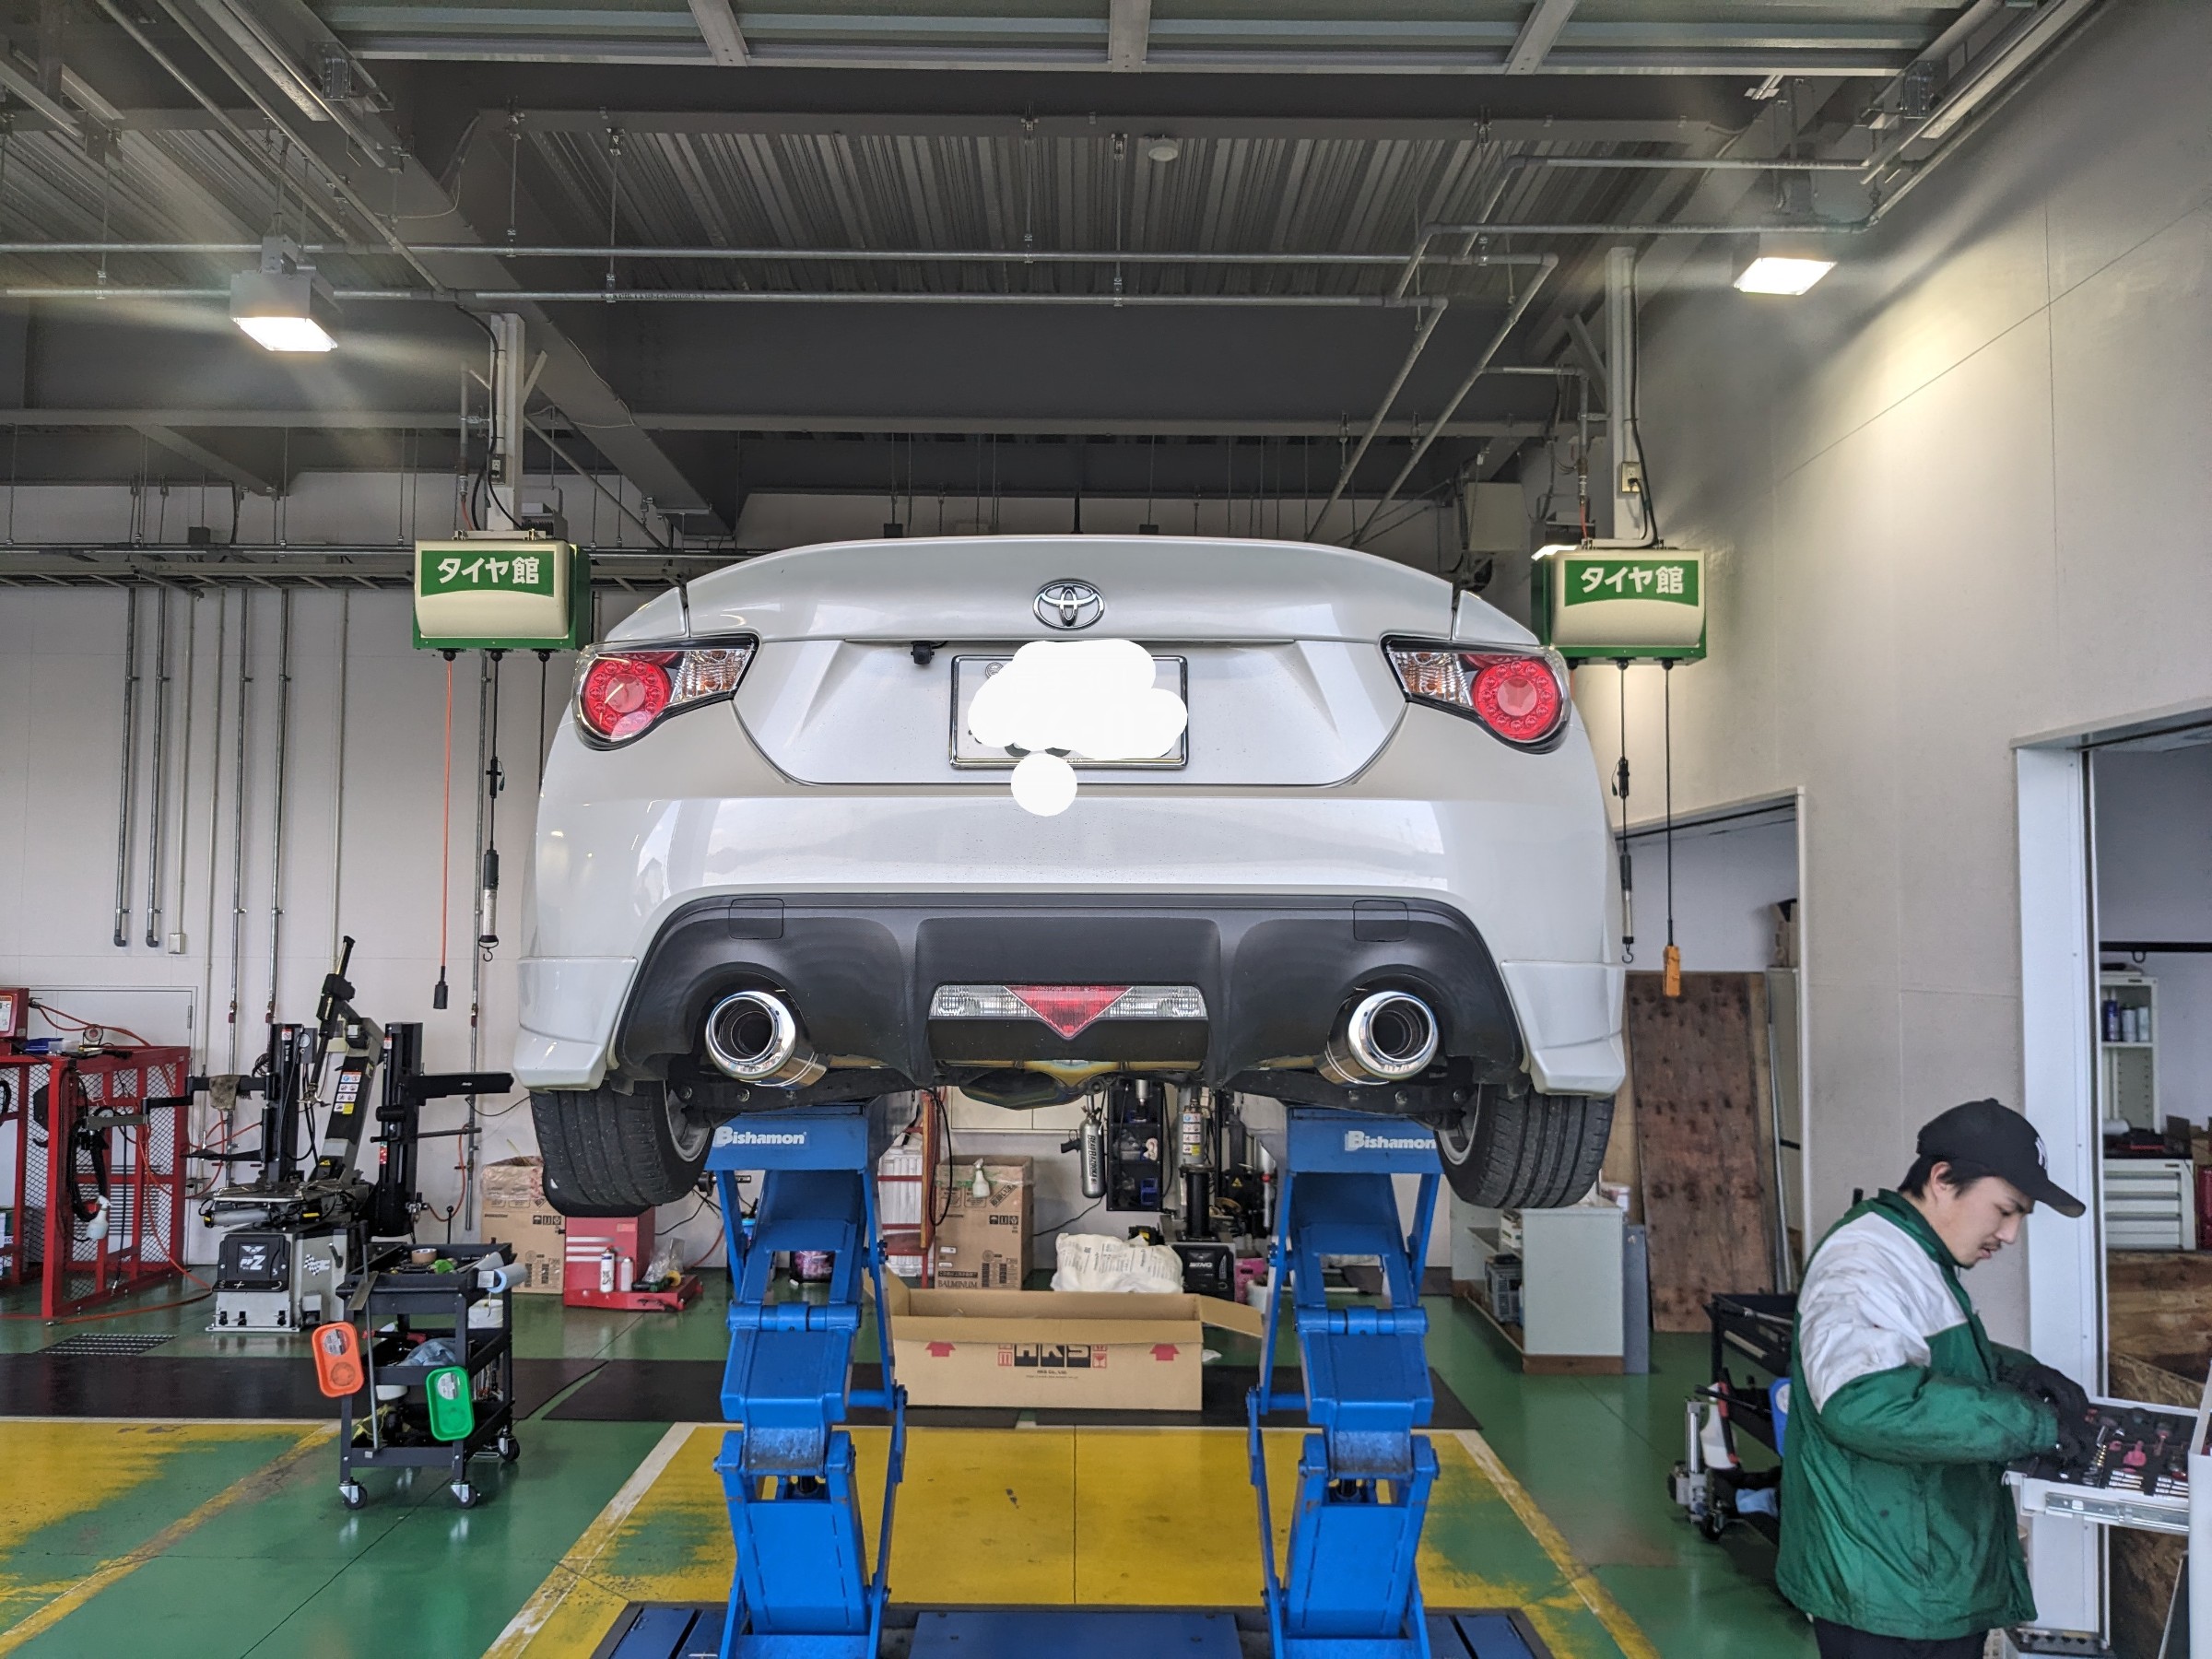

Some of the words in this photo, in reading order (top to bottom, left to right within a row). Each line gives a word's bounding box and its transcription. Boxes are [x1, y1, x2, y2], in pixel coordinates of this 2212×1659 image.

[437, 556, 540, 584] タイヤ館
[1580, 565, 1684, 594] タイヤ館
[712, 1125, 806, 1147] Bishamon
[1345, 1130, 1437, 1151] Bishamon
